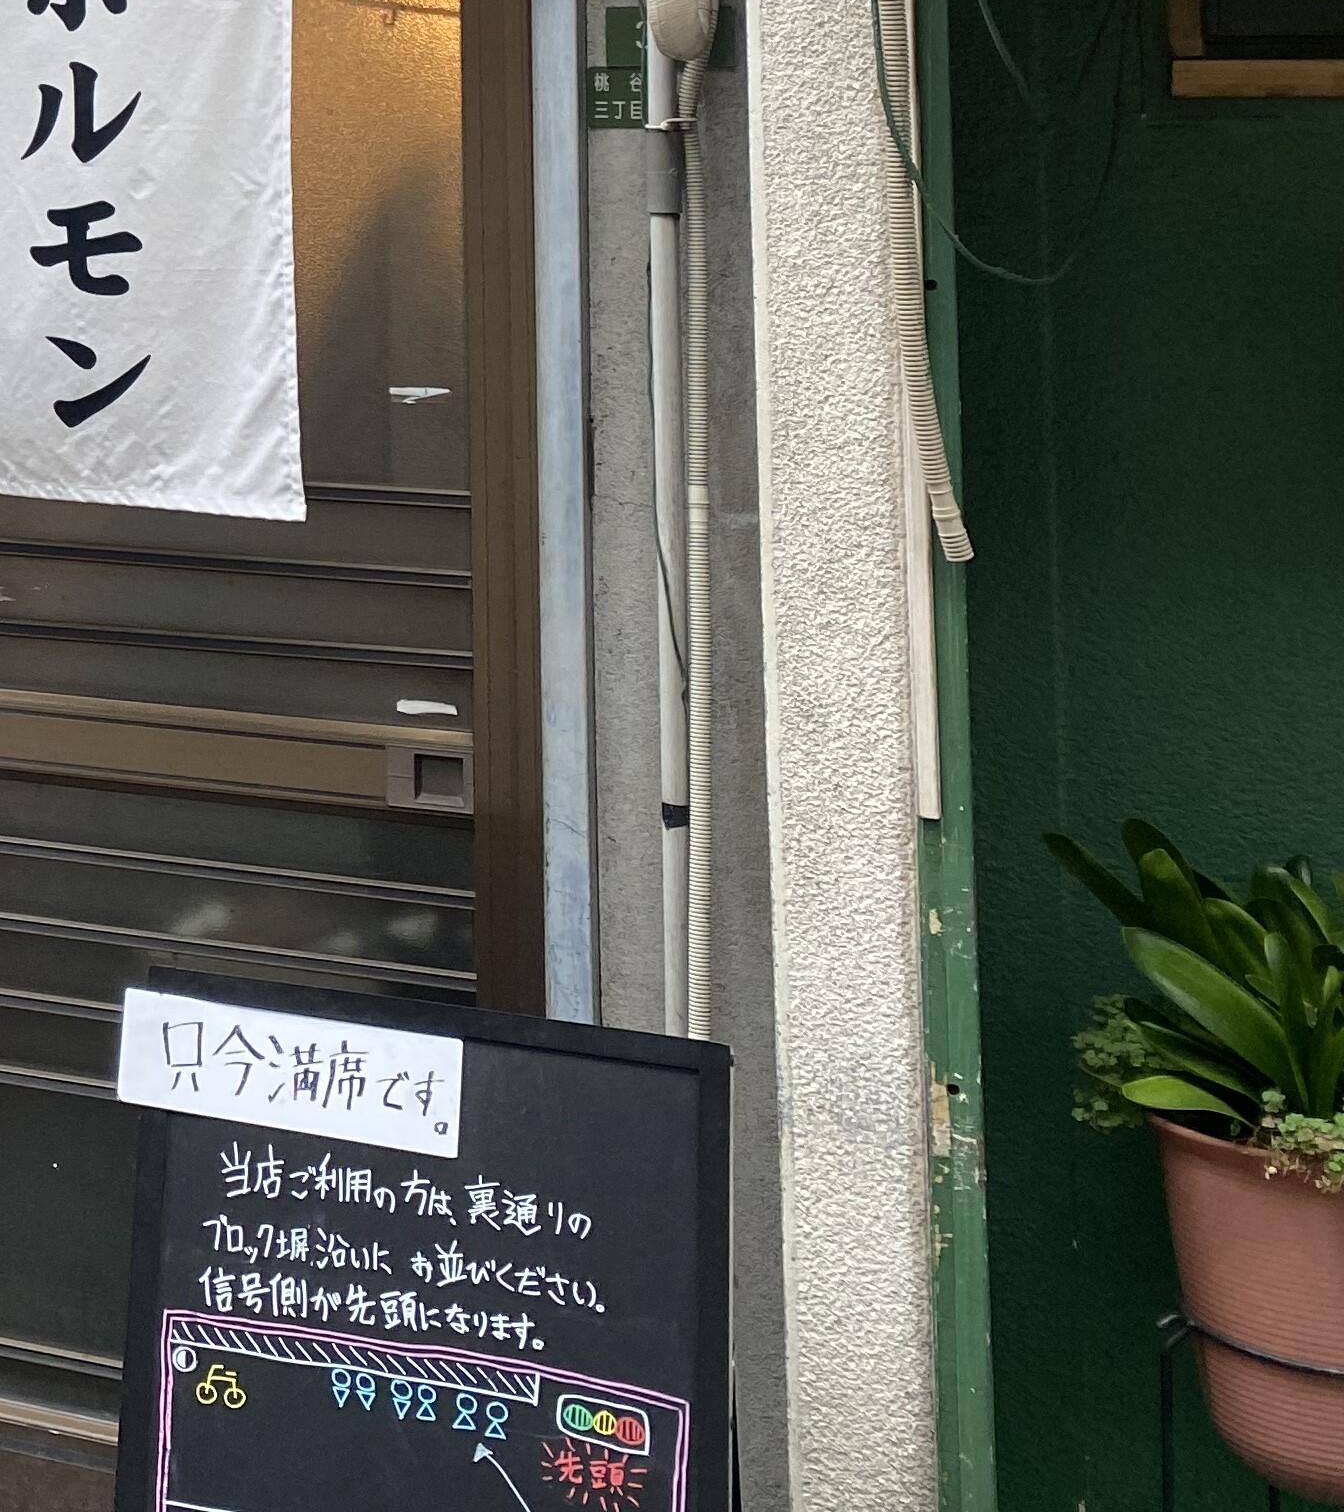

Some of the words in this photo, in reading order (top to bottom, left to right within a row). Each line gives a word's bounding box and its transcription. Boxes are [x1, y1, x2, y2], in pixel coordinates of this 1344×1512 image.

[594, 100, 643, 120] 三丁目
[161, 1019, 449, 1137] 只今満席です。
[198, 1267, 545, 1352] 信号側が先頭になります。
[553, 1450, 627, 1490] 先頭
